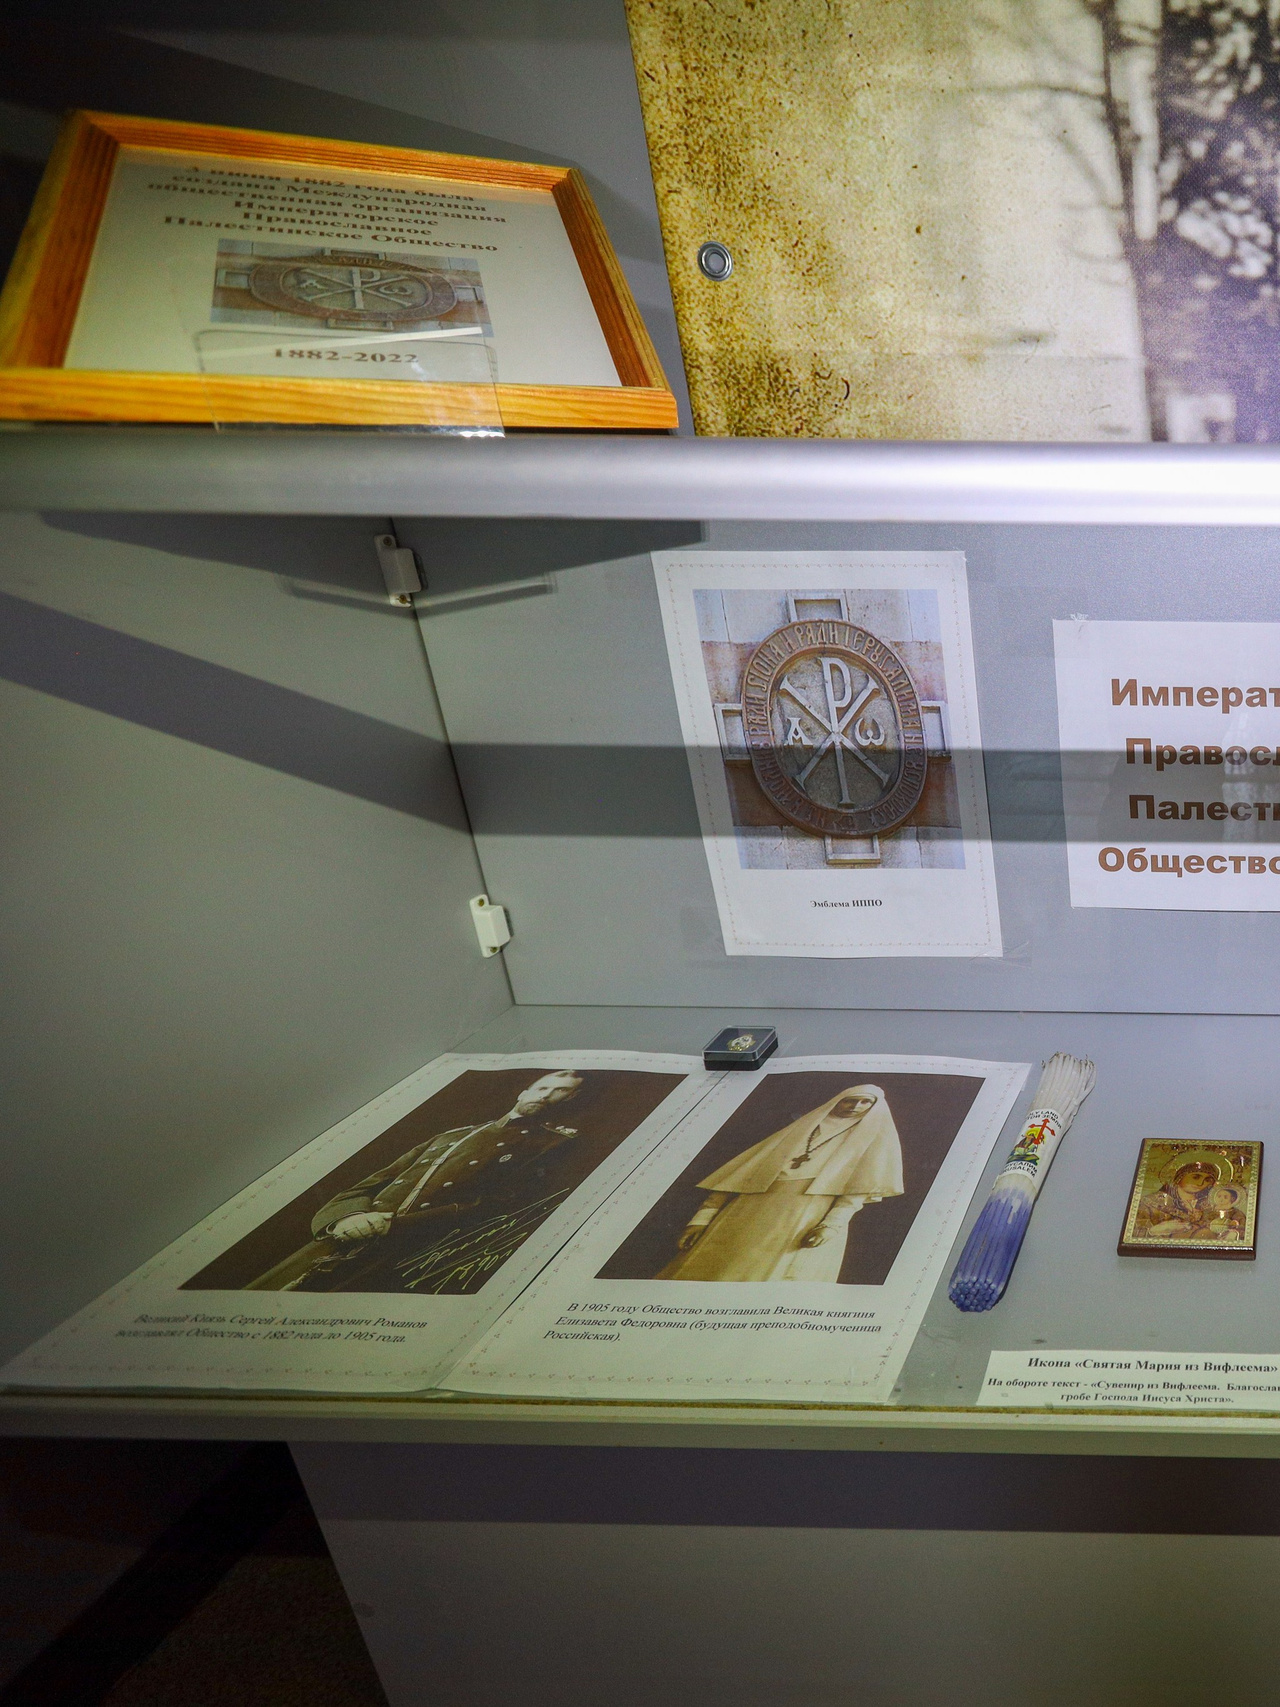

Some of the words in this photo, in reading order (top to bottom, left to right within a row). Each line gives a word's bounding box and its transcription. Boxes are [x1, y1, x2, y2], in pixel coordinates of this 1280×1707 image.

[234, 200, 438, 226] Императорское
[242, 211, 432, 235] Православное
[274, 348, 418, 363] 1882-2022
[851, 898, 882, 907] ИППО
[580, 1302, 611, 1312] 1905
[609, 1305, 640, 1314] году
[641, 1304, 702, 1315] Общество
[772, 1306, 824, 1316] Великая
[825, 1310, 876, 1318] княгиня
[554, 1316, 617, 1326] Елизавета
[620, 1317, 687, 1330] Федоровна
[688, 1319, 748, 1331] (будущая
[748, 1321, 881, 1334] преподобномученица
[542, 1330, 622, 1342] Российская).
[1027, 1357, 1070, 1367] Икона
[1074, 1358, 1131, 1369] «Святая
[1135, 1360, 1181, 1372] Мария
[1203, 1361, 1278, 1374] Вифлеема»
[1005, 1378, 1048, 1388] обороте
[1090, 1380, 1144, 1391] «Сувенир
[1162, 1381, 1220, 1391] Вифлеема.
[1060, 1392, 1091, 1402] гробе
[1093, 1393, 1138, 1401] Господа
[1141, 1393, 1181, 1402] Иисуса
[1184, 1394, 1235, 1404] Христа».
